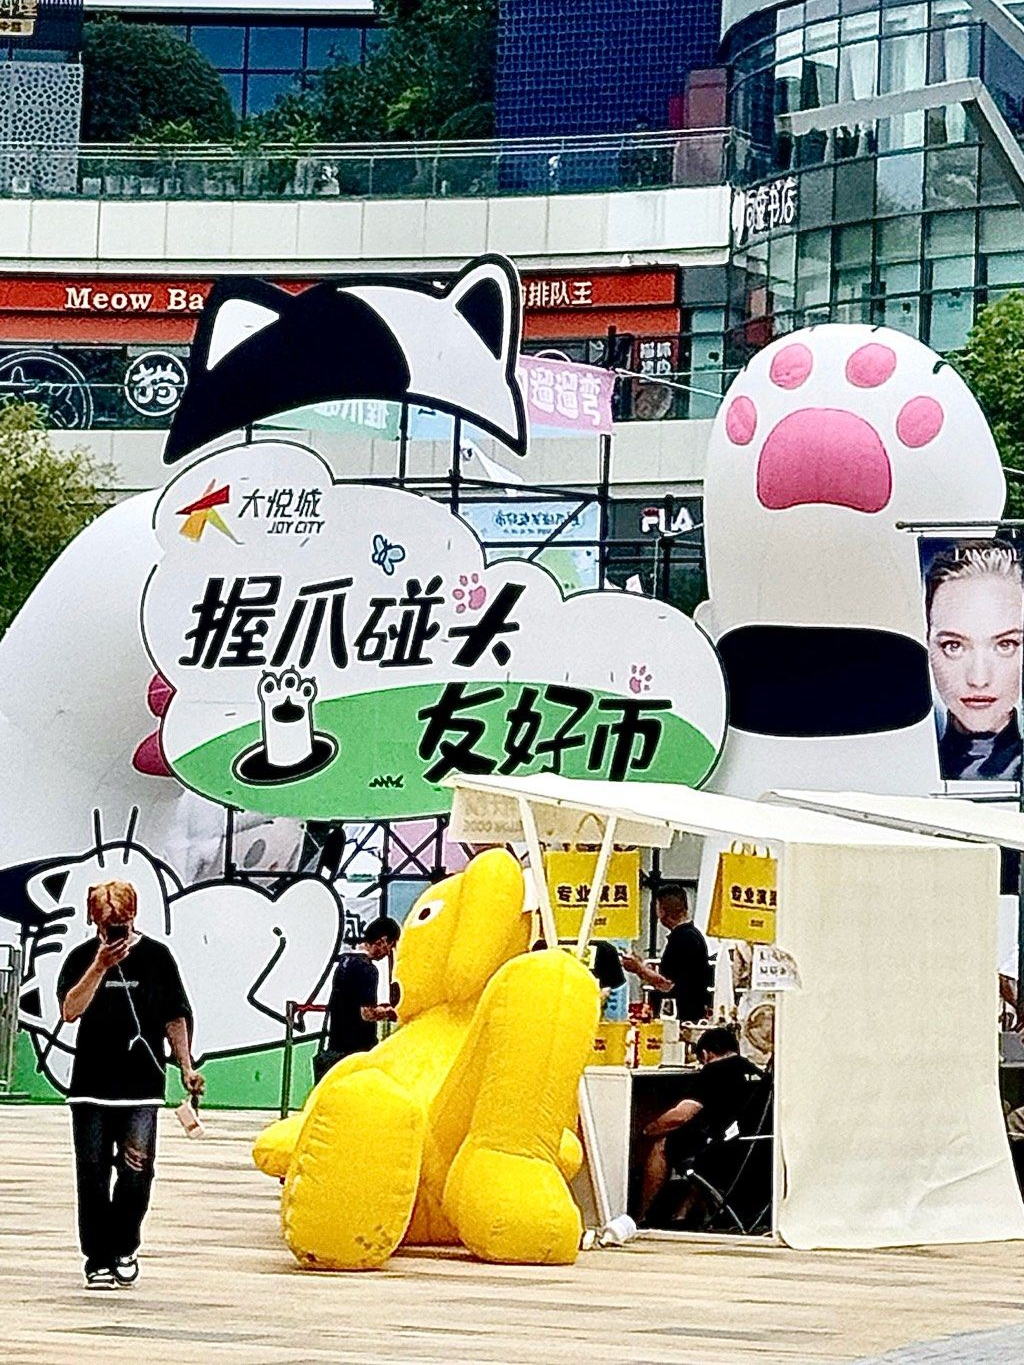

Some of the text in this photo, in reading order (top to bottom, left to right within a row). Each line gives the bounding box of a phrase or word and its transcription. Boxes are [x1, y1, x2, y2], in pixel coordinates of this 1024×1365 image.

[65, 288, 152, 310] Meow
[238, 486, 322, 519] 大悦城
[267, 521, 325, 534] JOY CITY
[179, 575, 526, 669] 握爪碰头
[418, 681, 673, 783] 友好市
